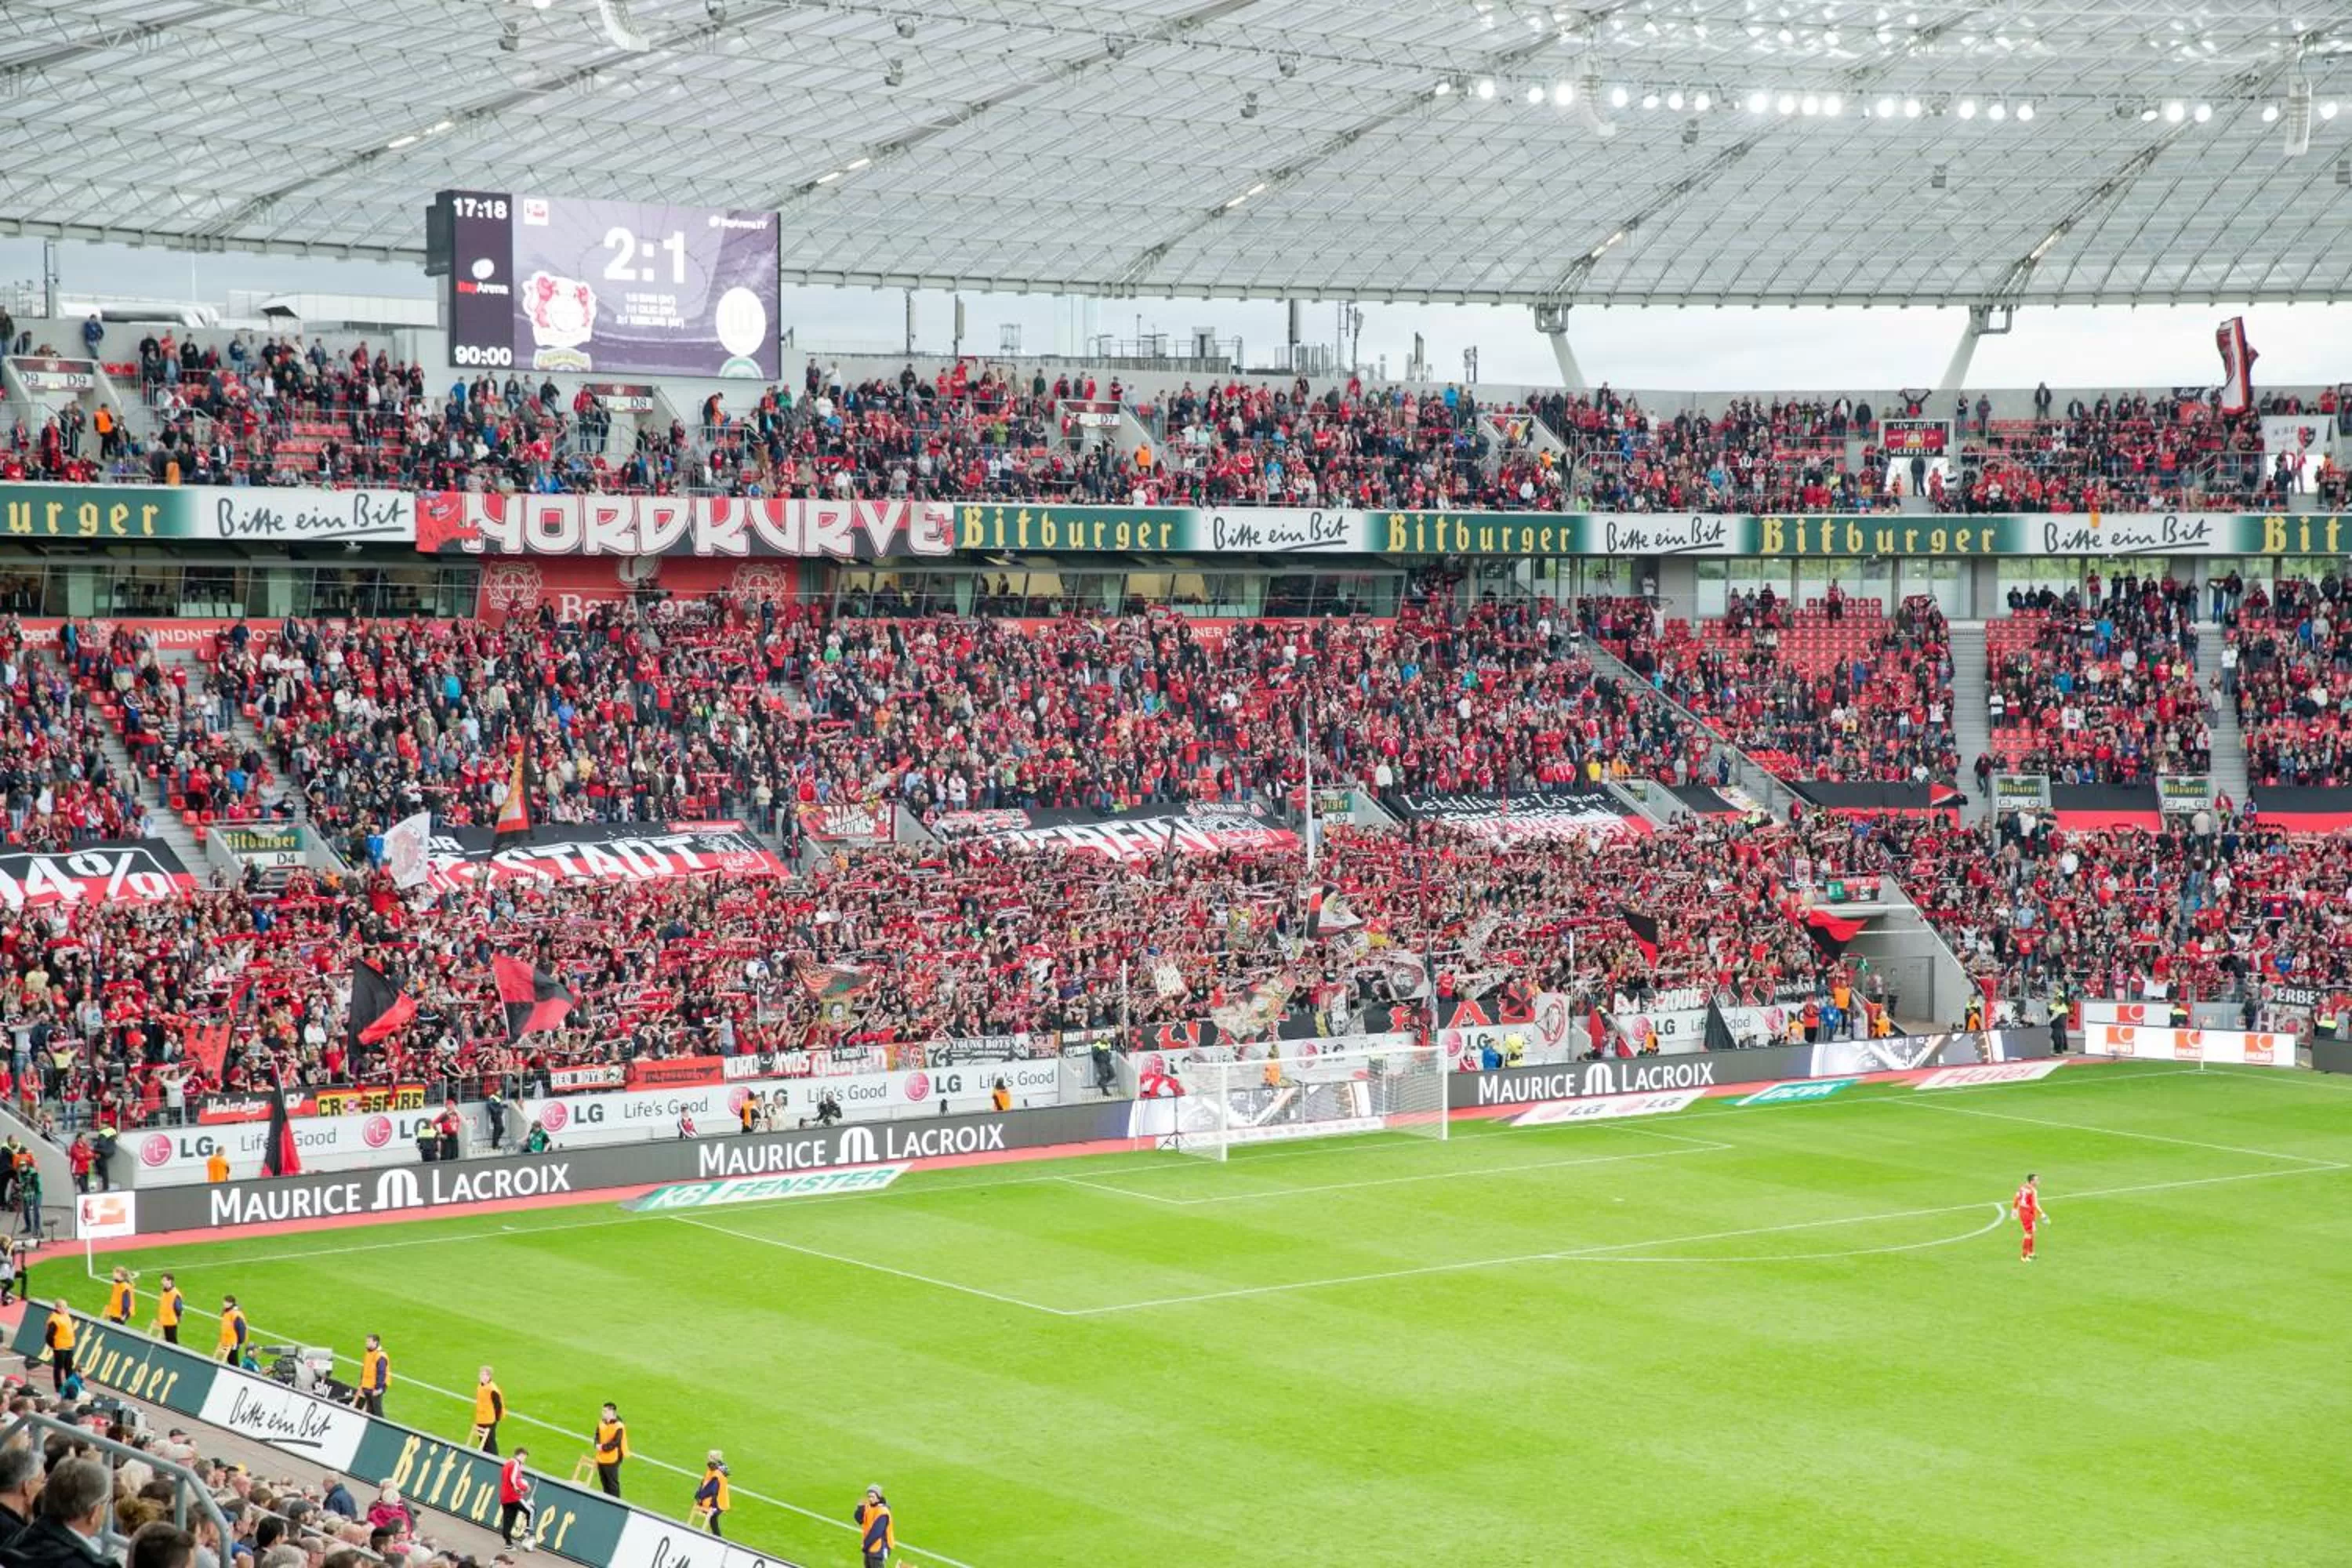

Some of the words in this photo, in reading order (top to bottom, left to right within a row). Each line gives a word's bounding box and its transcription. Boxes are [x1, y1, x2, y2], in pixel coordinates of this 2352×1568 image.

[453, 198, 507, 220] 17:18
[603, 227, 685, 284] 2:1
[456, 346, 512, 366] 90:00
[67, 373, 87, 387] D9
[7, 499, 159, 536] urger
[217, 498, 284, 537] Bitte
[296, 510, 346, 531] ein
[353, 493, 408, 528] Bit
[963, 506, 1173, 550] Bitburger
[1213, 517, 1260, 550] Bitte
[1268, 528, 1305, 545] ein
[1310, 512, 1349, 541] Bit
[1387, 514, 1572, 553] Bitburger
[1606, 521, 1650, 553] Bitte
[1655, 532, 1687, 548] ein
[1690, 517, 1727, 545] Bit
[1759, 517, 1996, 554] Bitburger
[2044, 521, 2103, 554] Bitte
[2111, 530, 2157, 546] ein
[2162, 515, 2212, 545] Bit
[2262, 515, 2340, 554] Bit
[277, 853, 296, 865] D4
[1467, 1033, 1489, 1051] LG
[1655, 1020, 1675, 1036] LG
[848, 1082, 887, 1101] Good
[935, 1074, 962, 1094] LG
[1019, 1071, 1054, 1086] Good
[1478, 1073, 1575, 1105] MAURICE
[1622, 1062, 1715, 1092] LACROIX
[574, 1103, 604, 1124] LG
[624, 1099, 663, 1119] Life's
[668, 1097, 708, 1116] Good
[180, 1136, 214, 1159] LG
[699, 1139, 826, 1178] MAURICE
[887, 1123, 1005, 1160] LACROIX
[210, 1183, 362, 1226] MAURICE
[432, 1163, 572, 1206] LACROIX
[229, 1386, 265, 1427] Bitte
[267, 1411, 296, 1433] ein
[299, 1402, 332, 1439] Bit
